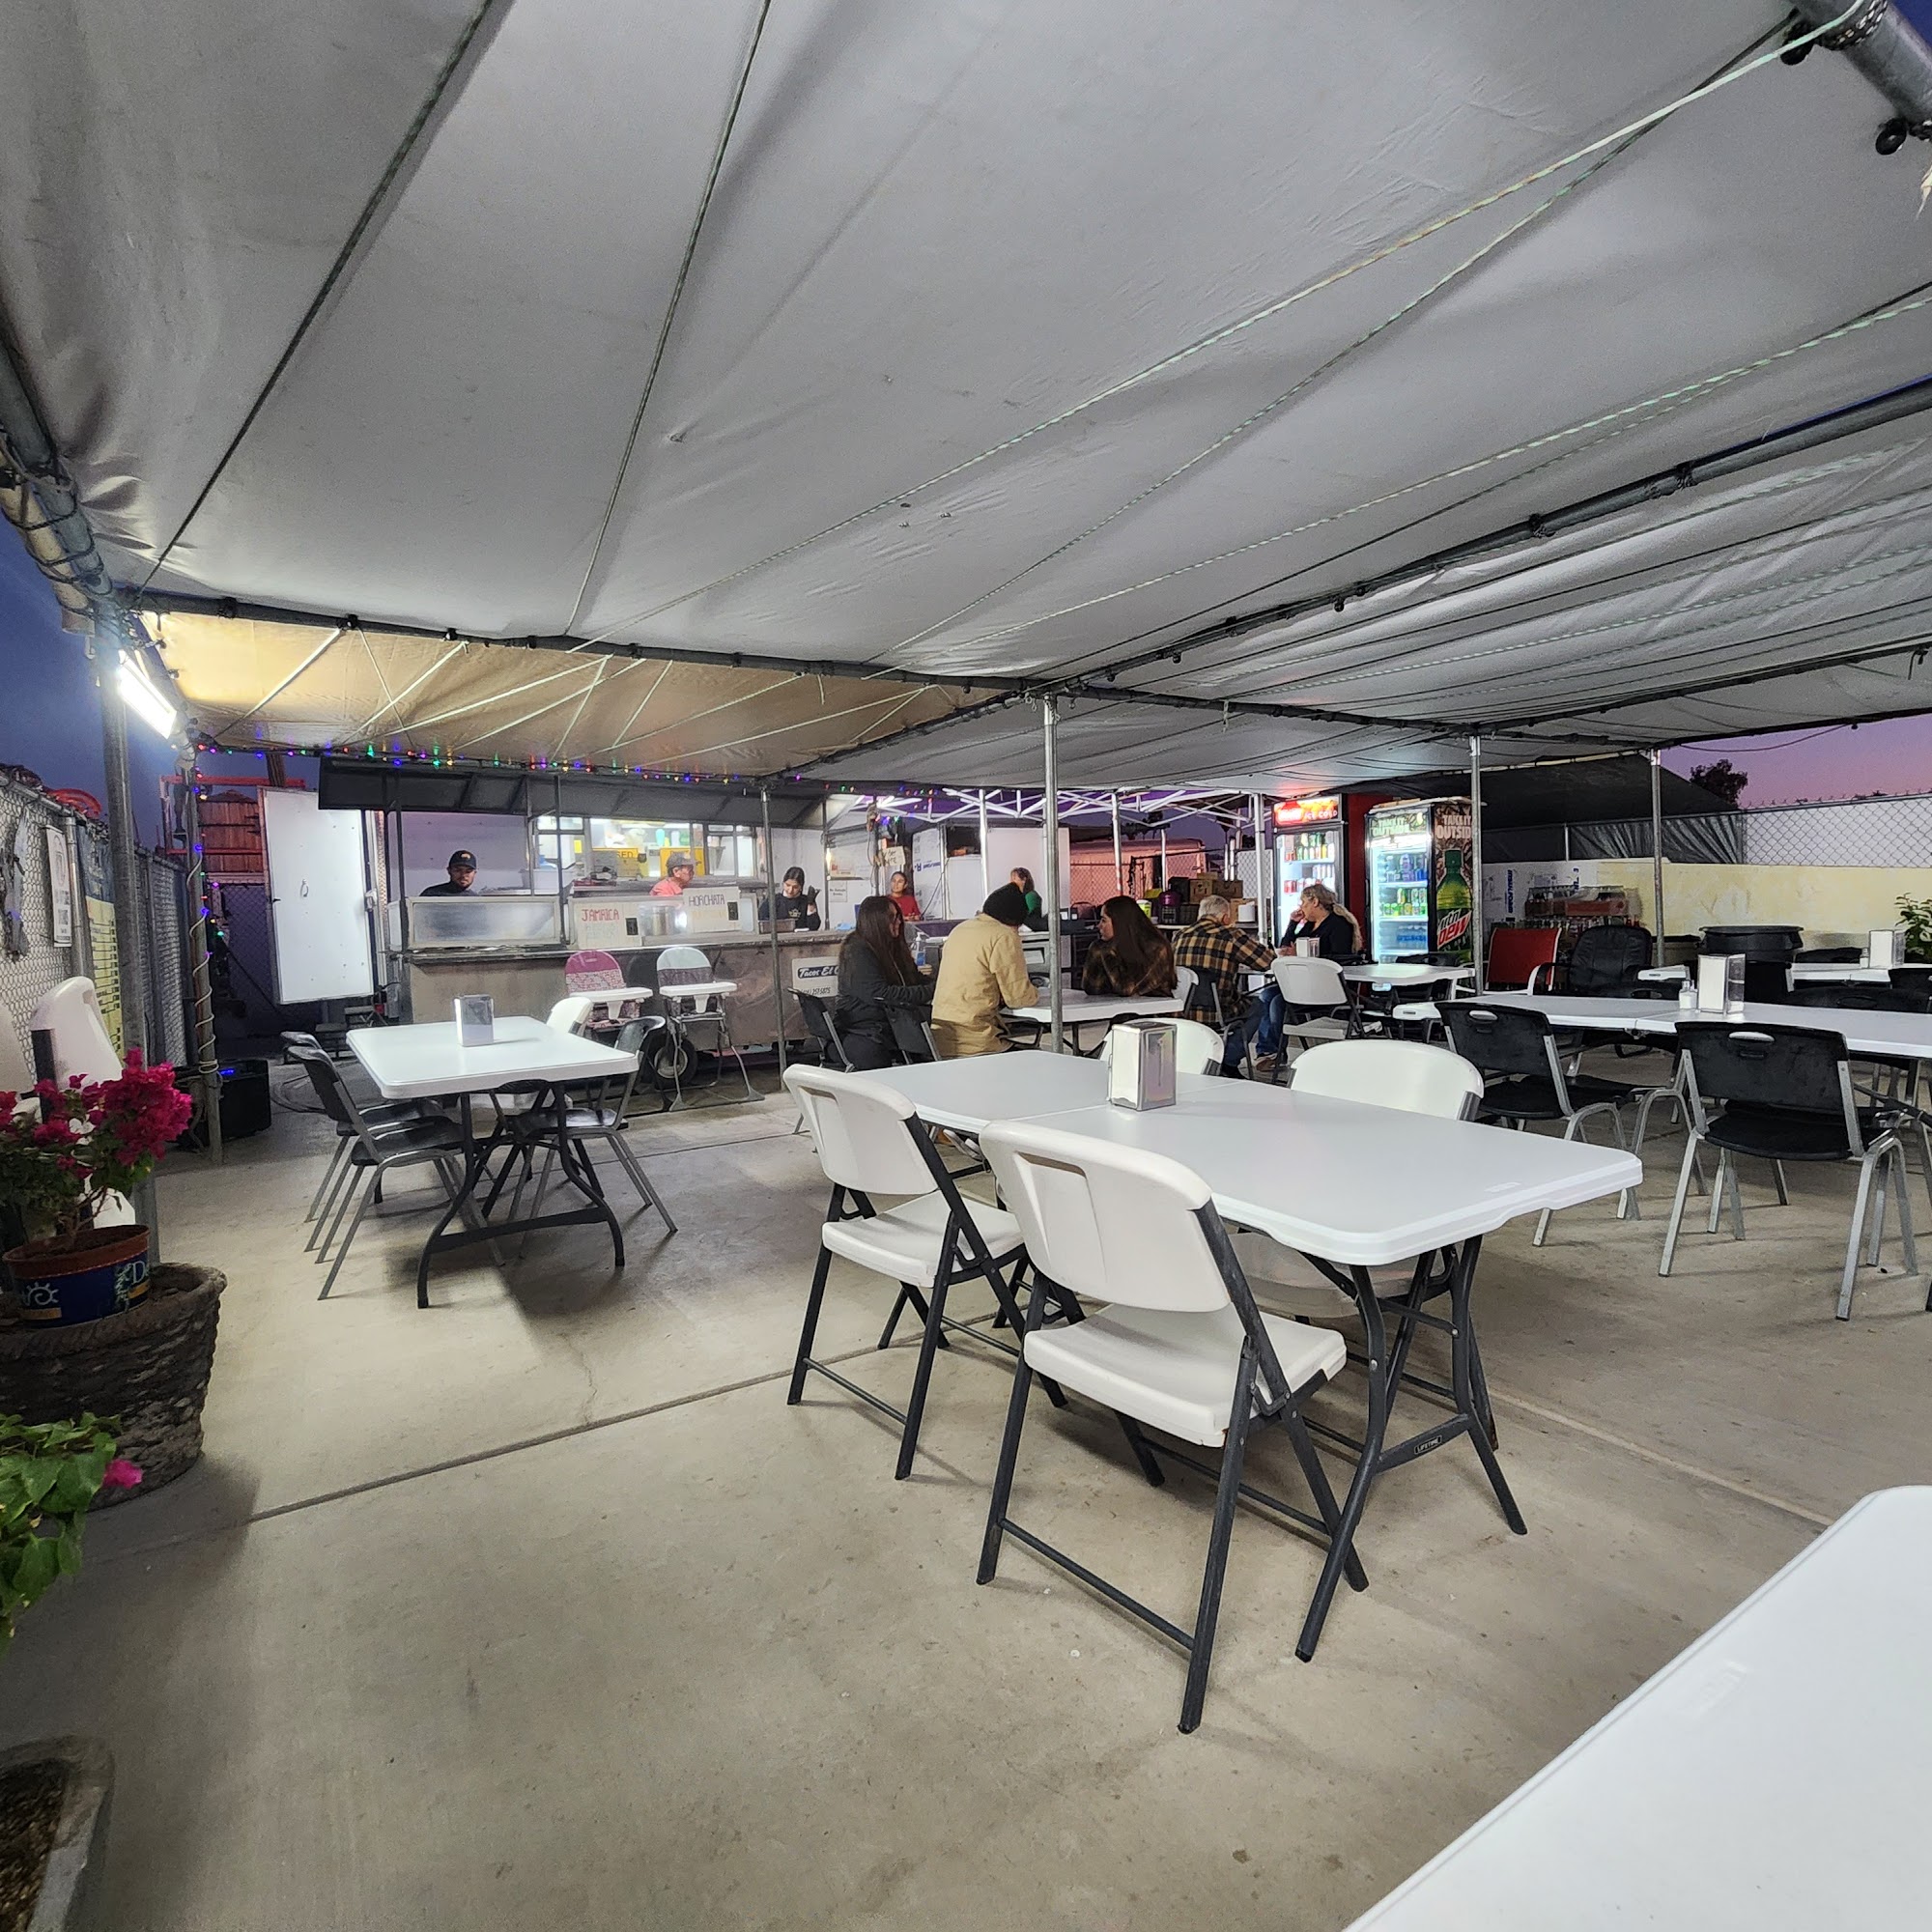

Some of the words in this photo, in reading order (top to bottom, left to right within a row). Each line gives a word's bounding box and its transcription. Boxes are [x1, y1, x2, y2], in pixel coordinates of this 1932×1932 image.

[1435, 825, 1472, 838] OUTSID
[688, 894, 725, 907] HORCHATA
[582, 908, 620, 923] JAMAICA
[800, 968, 819, 978] Tacos
[822, 966, 833, 976] El
